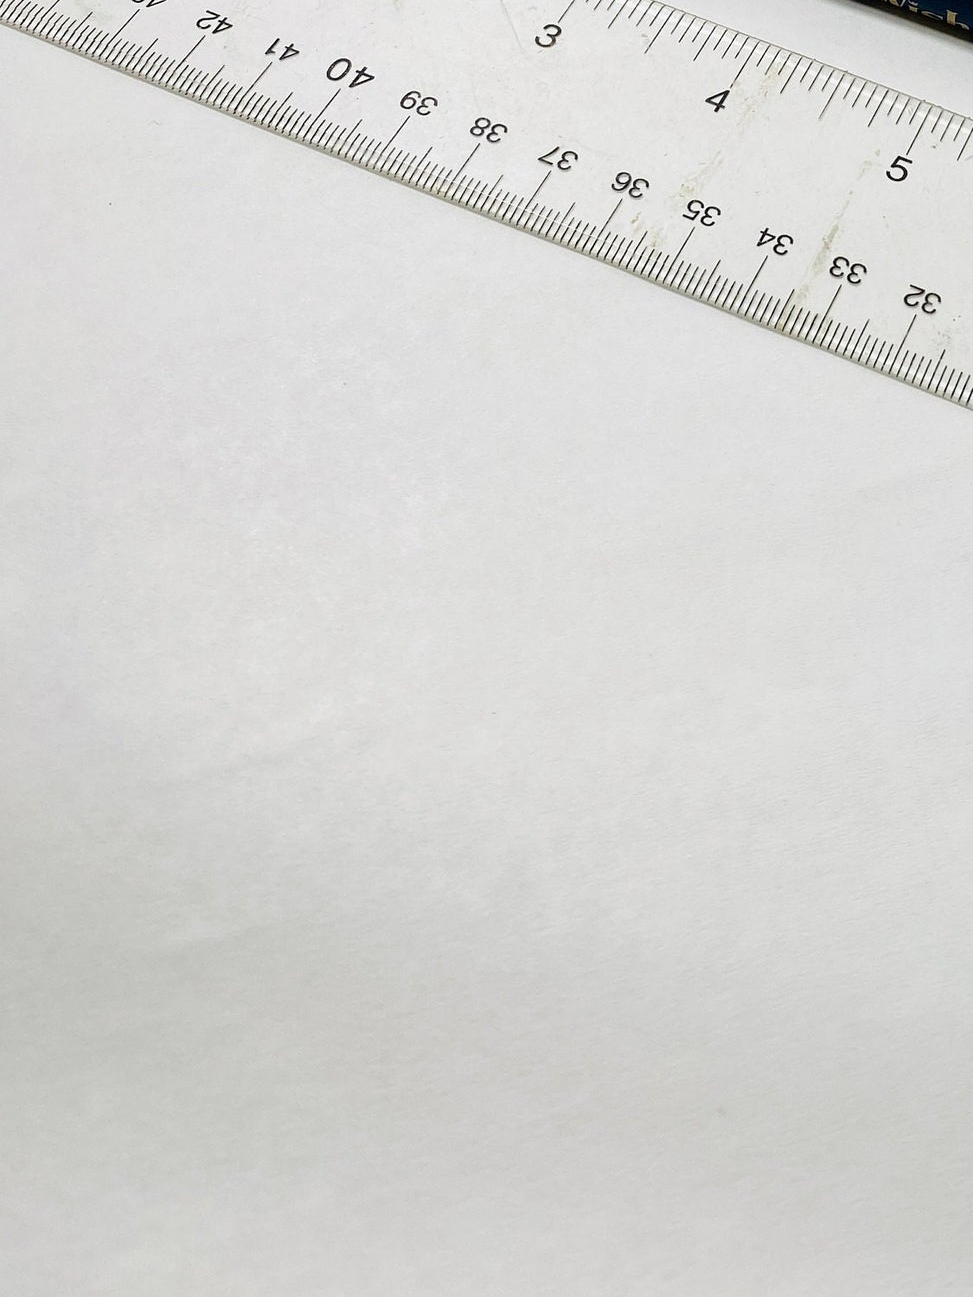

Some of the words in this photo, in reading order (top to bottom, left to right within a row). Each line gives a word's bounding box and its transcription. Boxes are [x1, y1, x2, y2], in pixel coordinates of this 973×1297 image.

[195, 9, 234, 35] 42
[533, 22, 563, 49] 3
[264, 36, 301, 62] 41
[324, 57, 376, 89] 40
[398, 89, 439, 117] 39
[704, 89, 732, 114] 4
[468, 116, 509, 145] 38
[537, 145, 579, 172] 37
[884, 155, 914, 182] 5
[610, 171, 651, 200] 36
[681, 198, 722, 228] 35
[755, 226, 795, 256] 34
[828, 255, 869, 285] 33
[902, 283, 943, 315] 32
